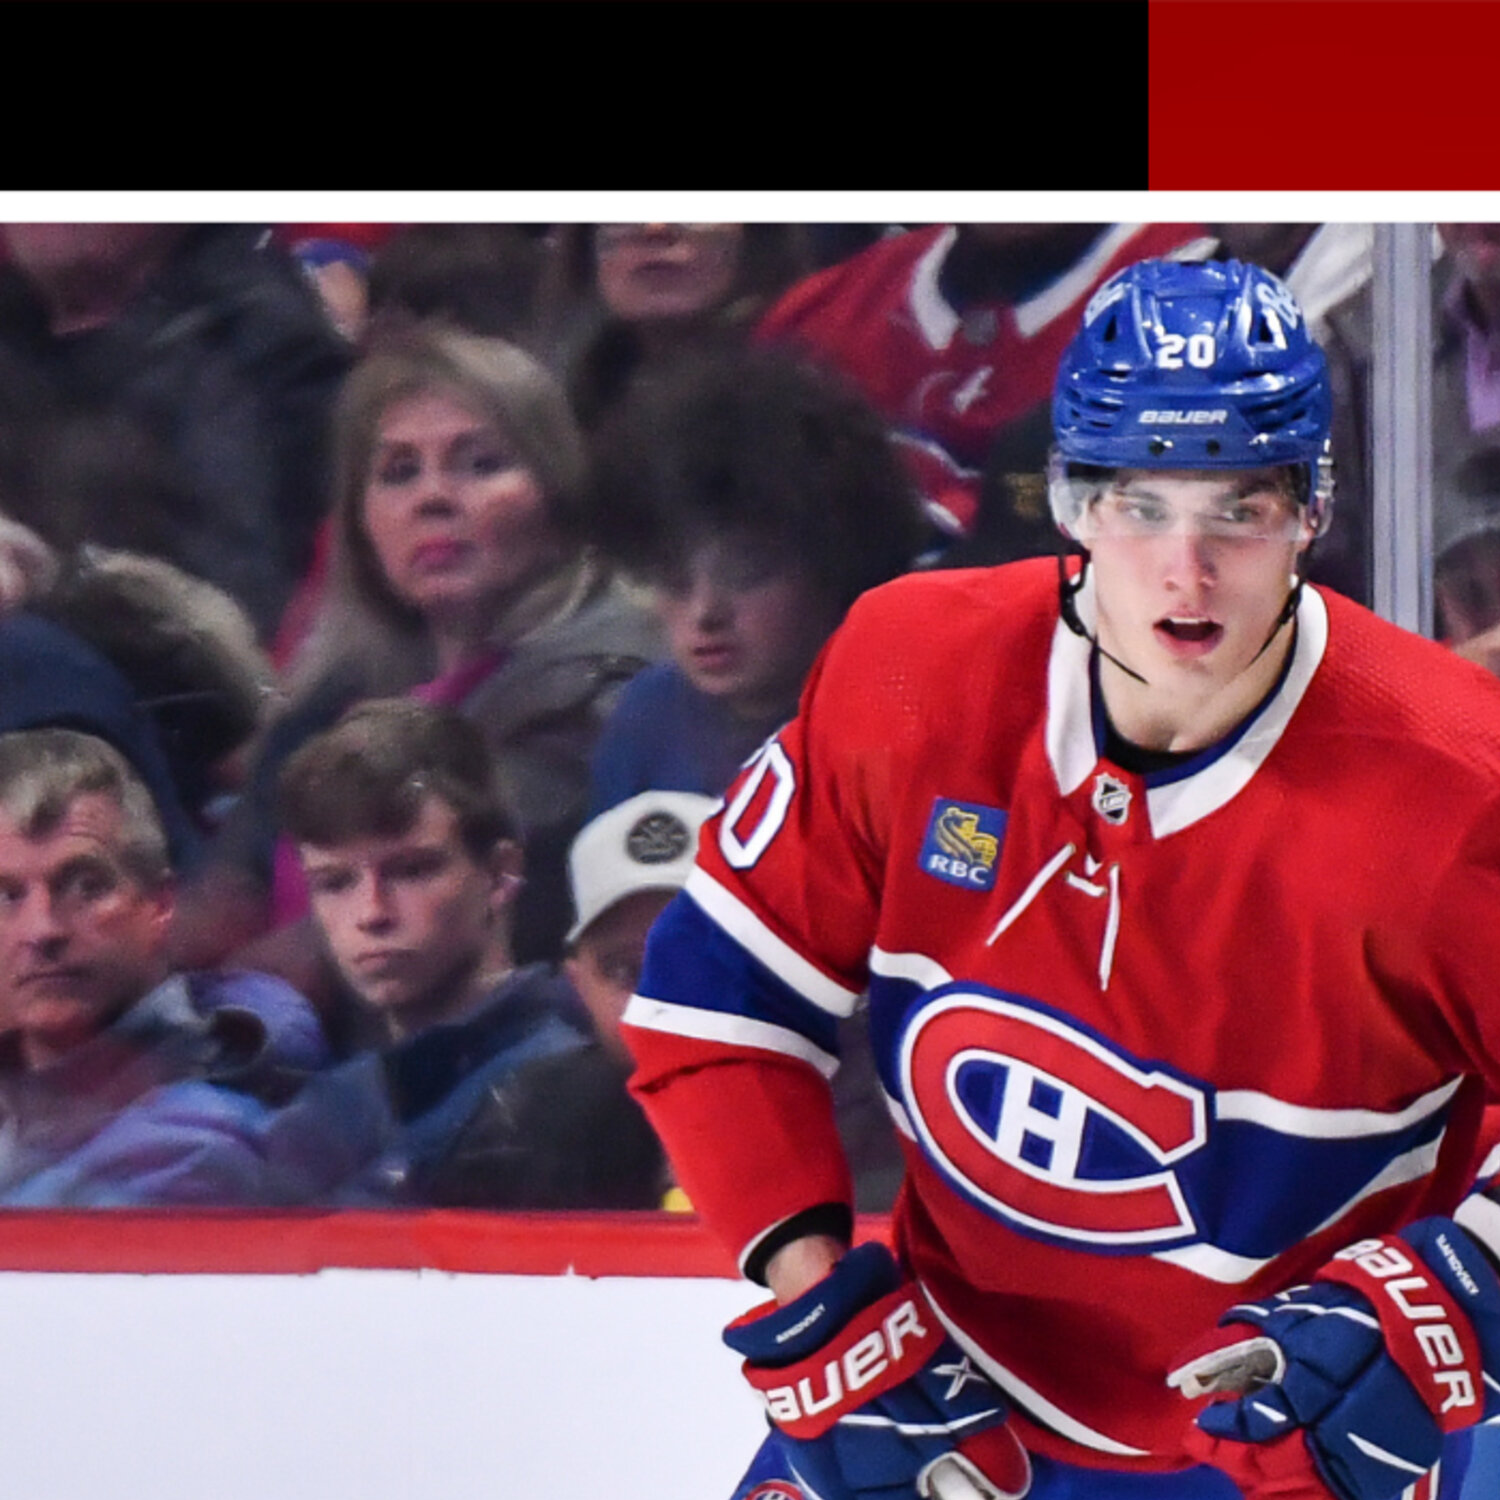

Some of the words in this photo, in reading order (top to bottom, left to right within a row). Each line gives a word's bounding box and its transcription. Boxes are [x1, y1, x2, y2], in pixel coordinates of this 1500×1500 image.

[1155, 334, 1217, 369] 20
[928, 853, 991, 885] RBC
[757, 1300, 928, 1423] AUER
